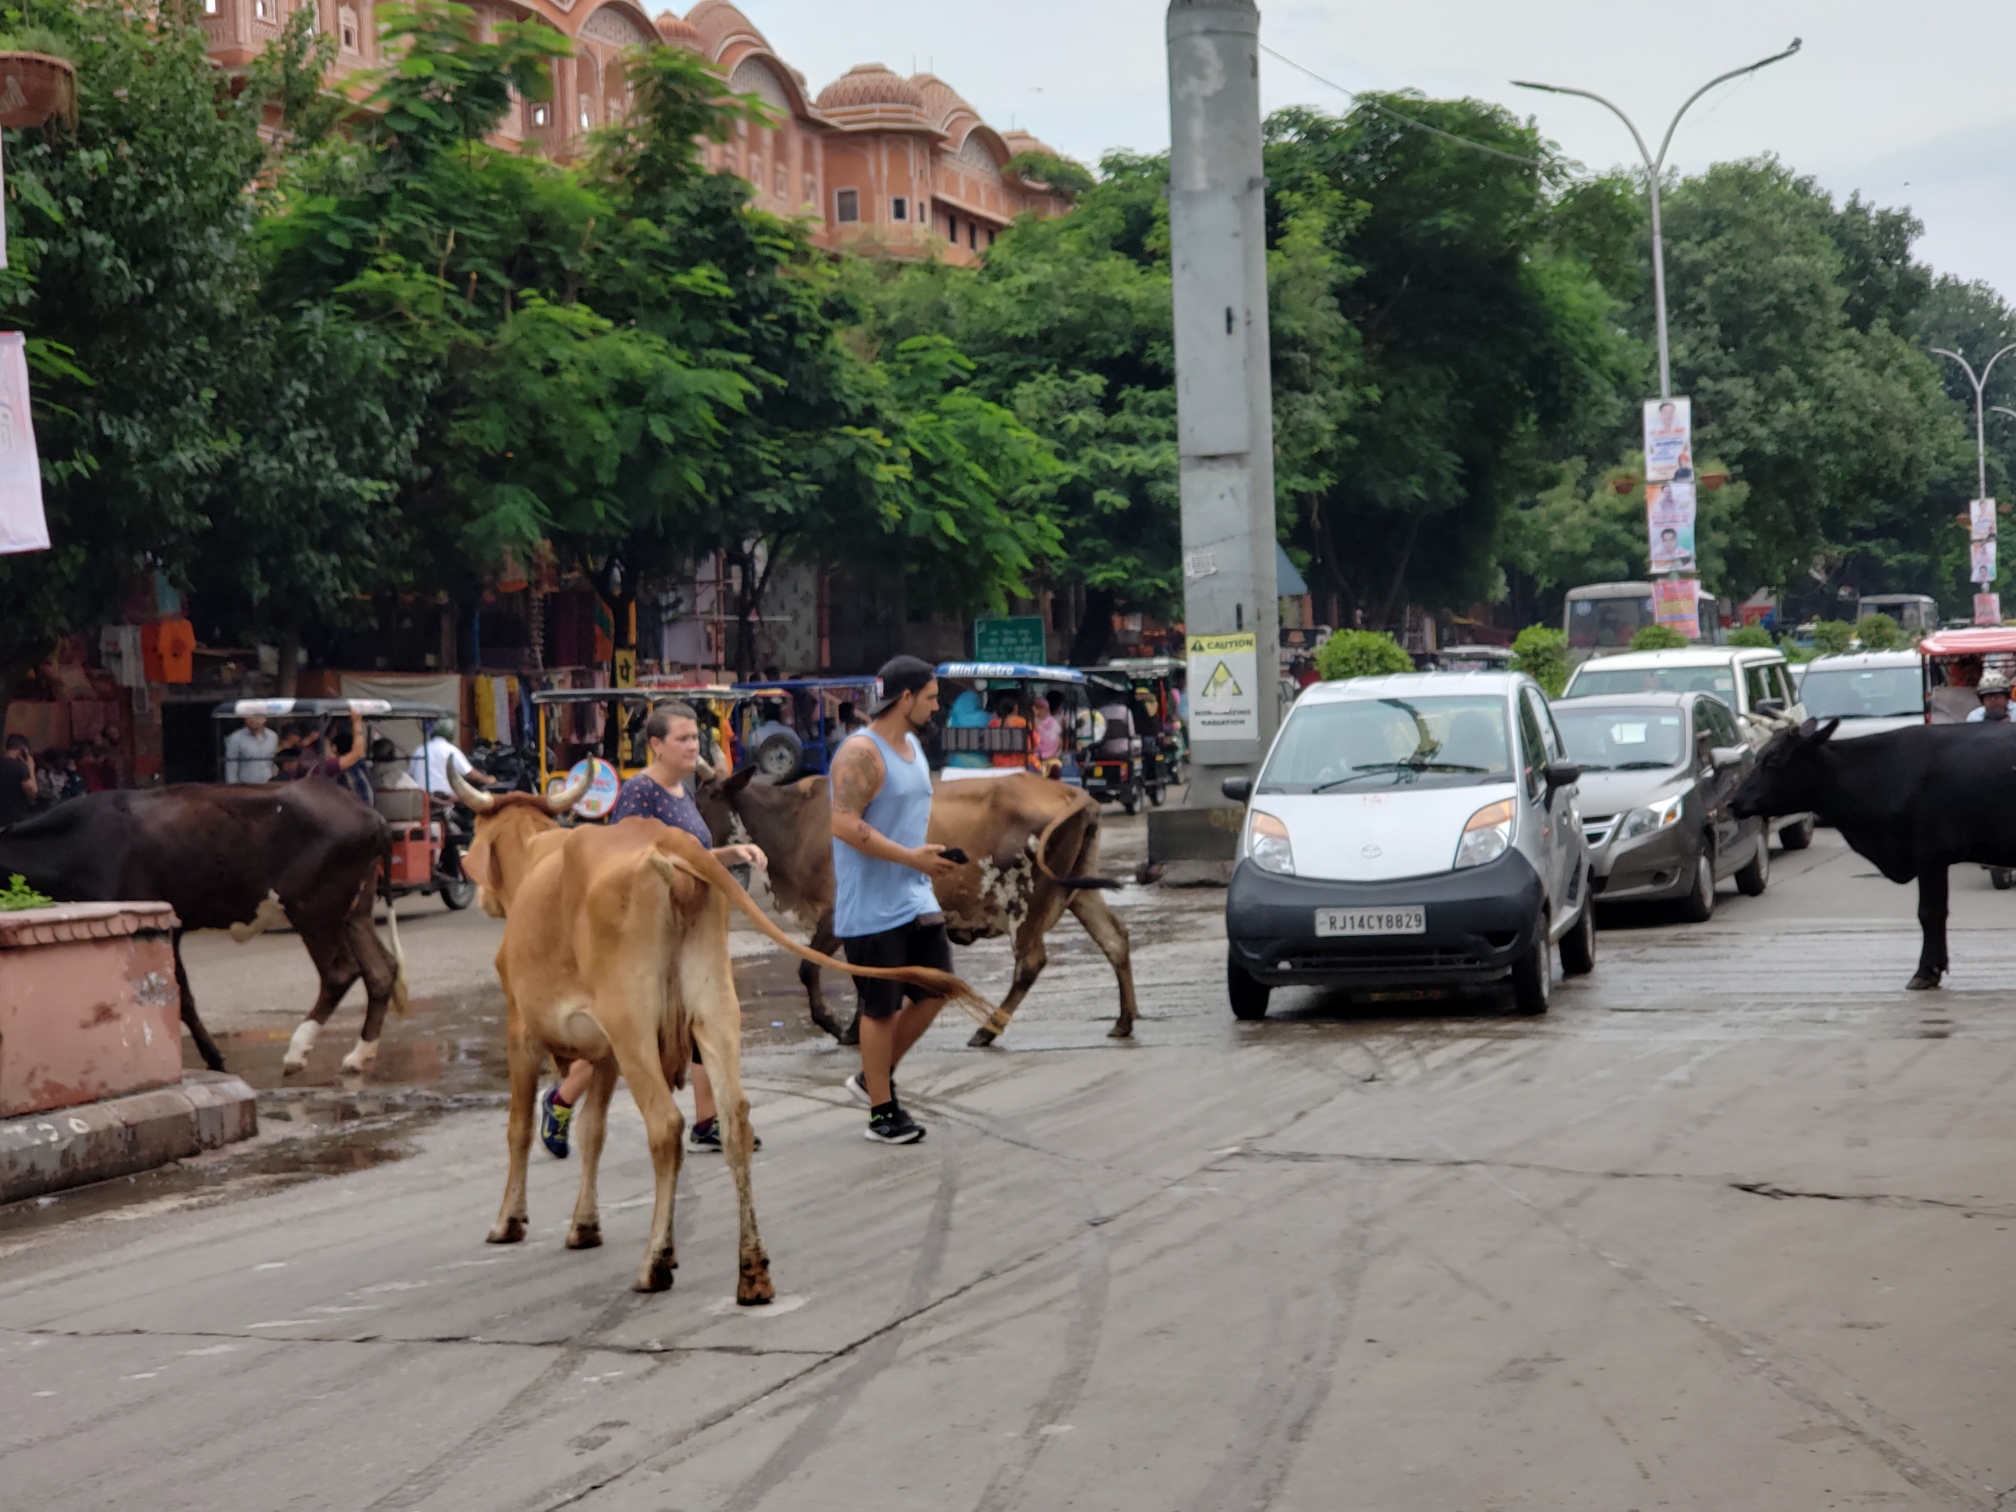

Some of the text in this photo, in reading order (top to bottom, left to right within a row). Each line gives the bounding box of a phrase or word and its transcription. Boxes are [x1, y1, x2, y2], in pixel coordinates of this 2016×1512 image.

[1207, 638, 1253, 650] CAUTION
[948, 664, 1015, 677] Mini Metro
[1328, 913, 1423, 931] RJ14CY8829
